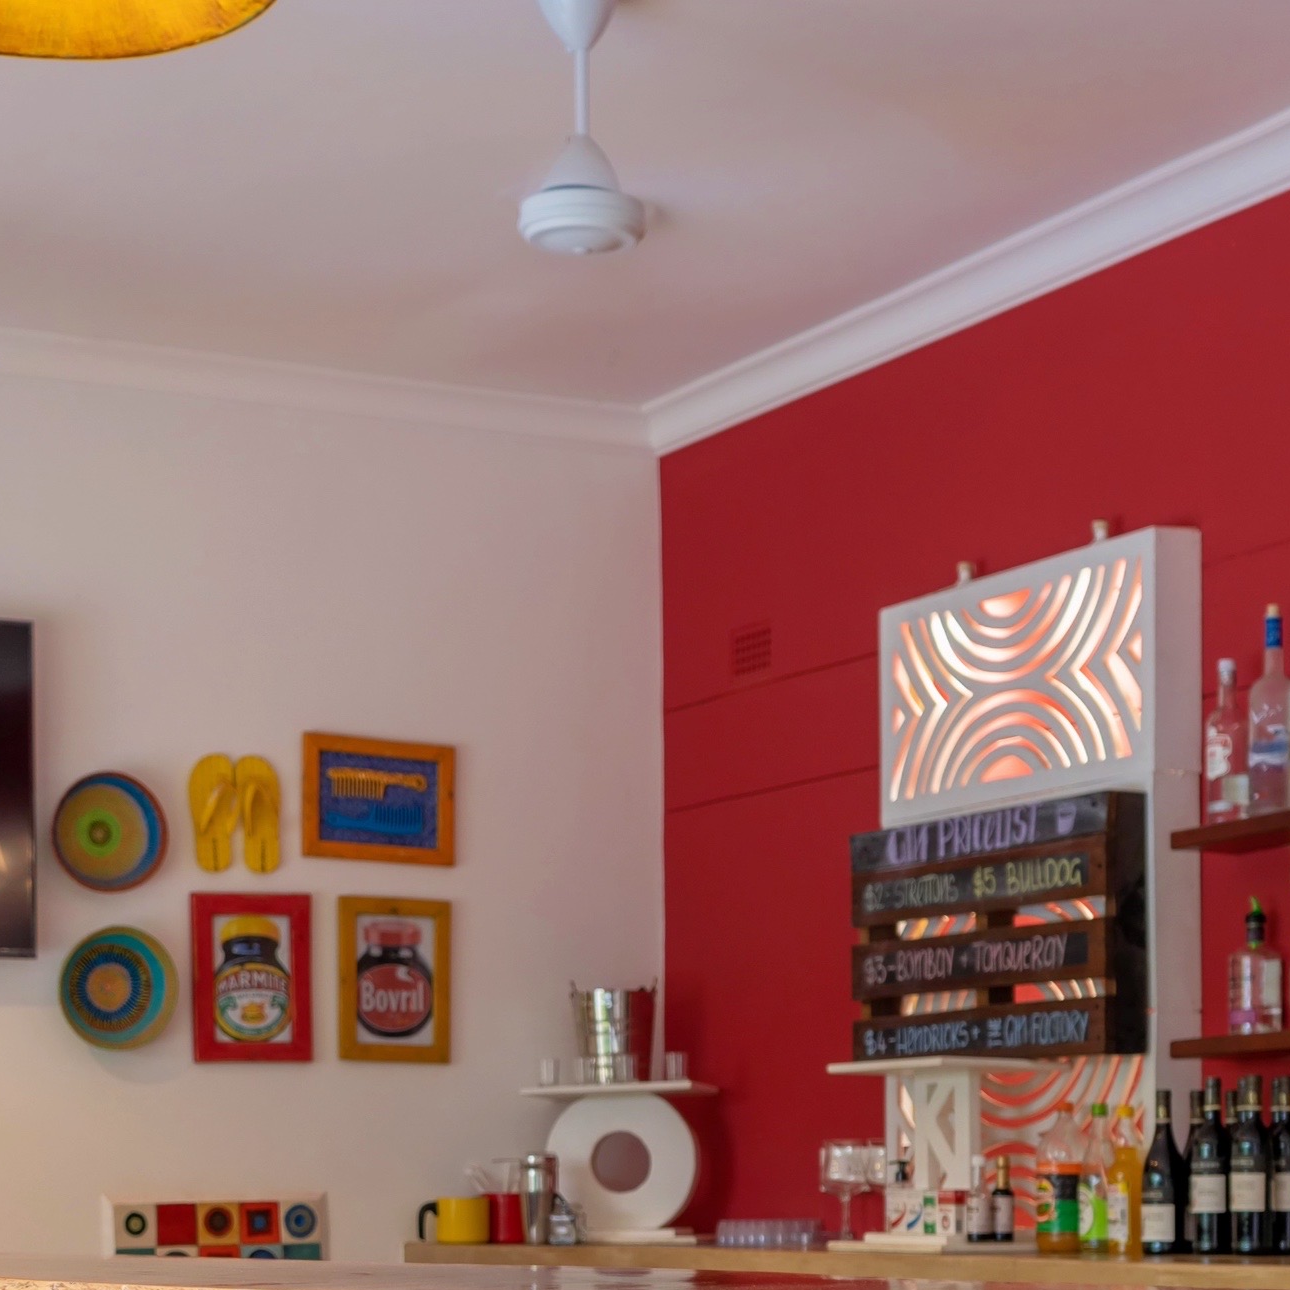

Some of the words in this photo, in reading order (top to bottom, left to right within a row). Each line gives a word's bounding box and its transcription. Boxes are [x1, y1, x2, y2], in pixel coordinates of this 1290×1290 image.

[973, 865, 996, 898] $5
[1005, 857, 1082, 896] BULLDOG
[216, 969, 288, 995] MARMITE
[360, 979, 425, 1013] Bovril
